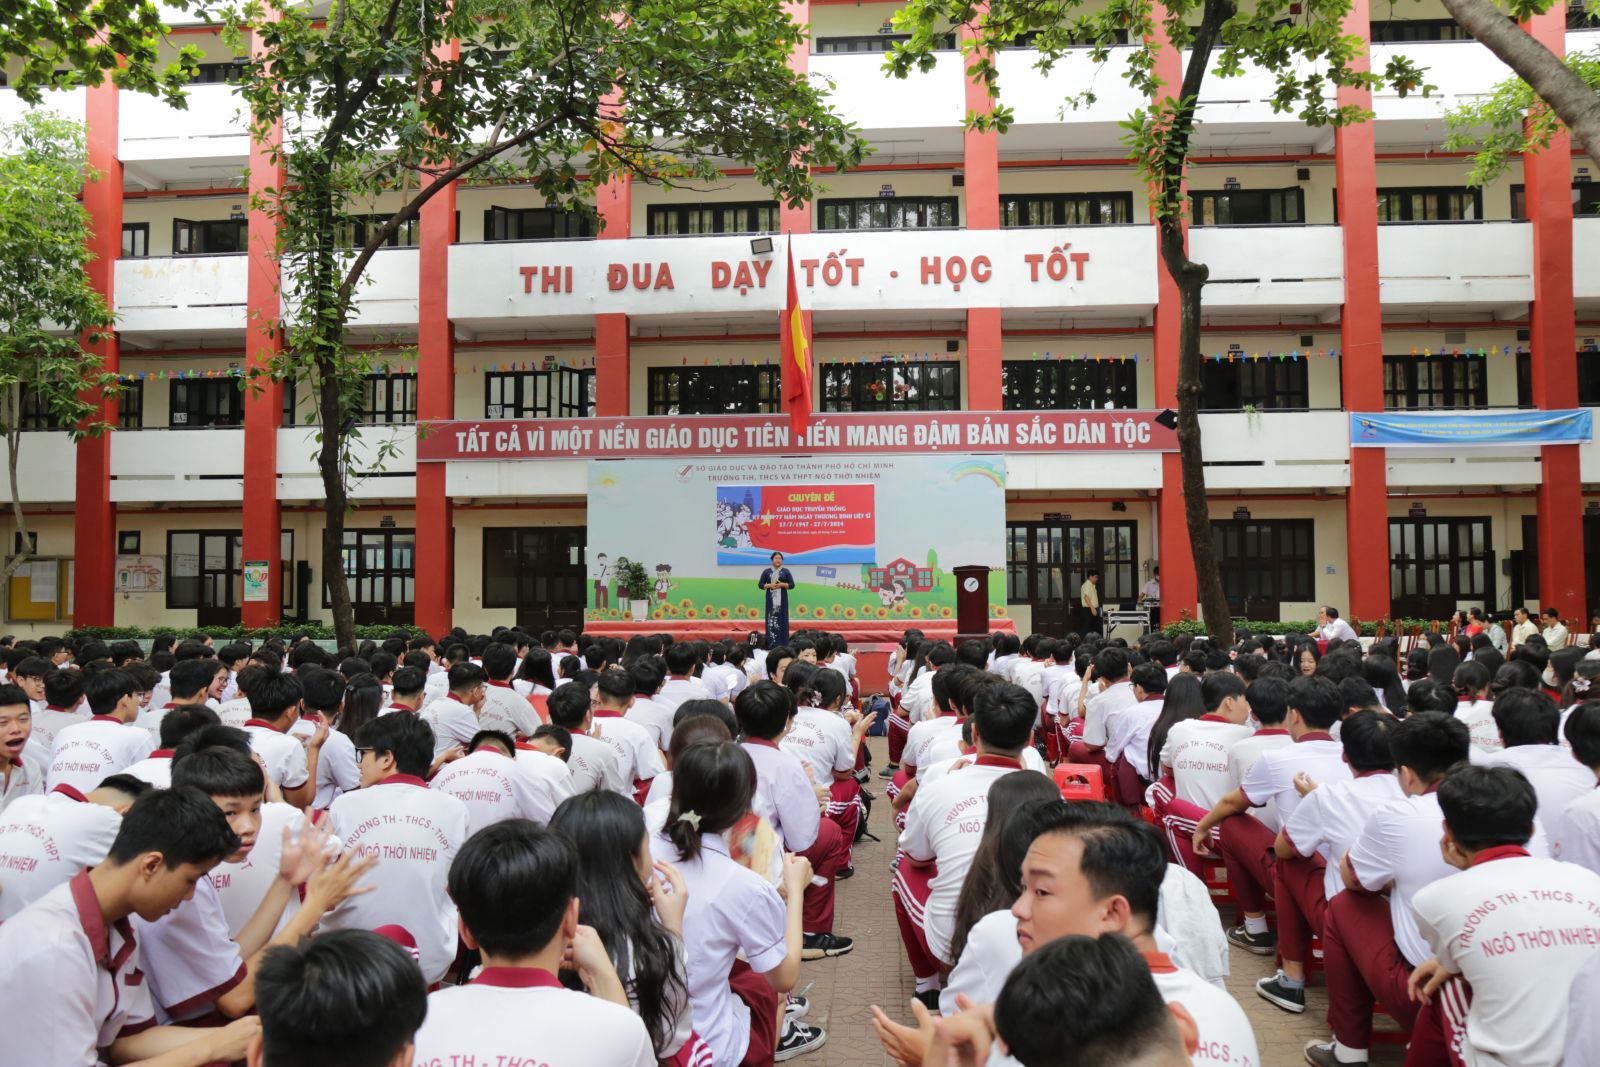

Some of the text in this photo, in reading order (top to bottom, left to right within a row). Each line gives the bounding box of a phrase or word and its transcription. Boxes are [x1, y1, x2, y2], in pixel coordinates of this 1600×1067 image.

[520, 266, 573, 293] THI
[607, 262, 674, 290] ĐUA
[711, 260, 772, 295] DẠY
[801, 249, 864, 287] TỐT
[921, 255, 992, 292] HỌC
[1025, 243, 1089, 281] TỐT
[456, 425, 489, 452] TẤT
[495, 424, 521, 452] CẢ
[526, 427, 545, 451] VÌ
[551, 425, 593, 454] MỘT
[599, 422, 639, 450] NỀN
[645, 424, 691, 449] GIÁO
[698, 427, 738, 452] DỤC
[744, 422, 789, 447] TIÊN
[847, 424, 907, 446] MANG
[914, 420, 961, 450] ĐẬM
[967, 416, 1009, 445] BẢN
[1016, 416, 1057, 445] SẮC
[1063, 418, 1106, 444] DÂN
[1112, 418, 1151, 448] TỘC
[707, 473, 739, 481] TRƯỜNG
[759, 473, 779, 481] THCS
[793, 472, 813, 480] THPT
[815, 472, 832, 480] NGÔ
[834, 472, 853, 480] THỜI
[855, 472, 880, 482] NHIỆM
[708, 464, 727, 472] GIÁO
[729, 464, 746, 472] DỤC
[747, 463, 758, 471] VÀ
[796, 462, 823, 470] THÀNH
[825, 462, 841, 470] PHỐ
[857, 462, 871, 470] CHÍ
[788, 490, 835, 502] CHUYÊN ĐỀ
[458, 769, 469, 777] TH
[476, 767, 498, 777] THCS
[500, 777, 513, 797] THPT
[475, 790, 501, 805] NHIỆM
[344, 816, 381, 849] TRƯỜNG
[382, 815, 396, 824] TH
[405, 815, 432, 829] THCS
[435, 828, 449, 851] THPT
[959, 819, 980, 833] NGÔ
[42, 836, 60, 862] THPT
[383, 843, 407, 859] THỜI
[410, 846, 437, 864] NHIỆM
[7, 855, 38, 873] NHIỆM
[1459, 899, 1498, 949] TRƯỜNG
[1496, 892, 1519, 905] TH
[1530, 890, 1574, 903] THCS
[1481, 931, 1516, 958] NGÔ
[1516, 926, 1558, 950] THỜI
[1198, 1041, 1230, 1062] HCS
